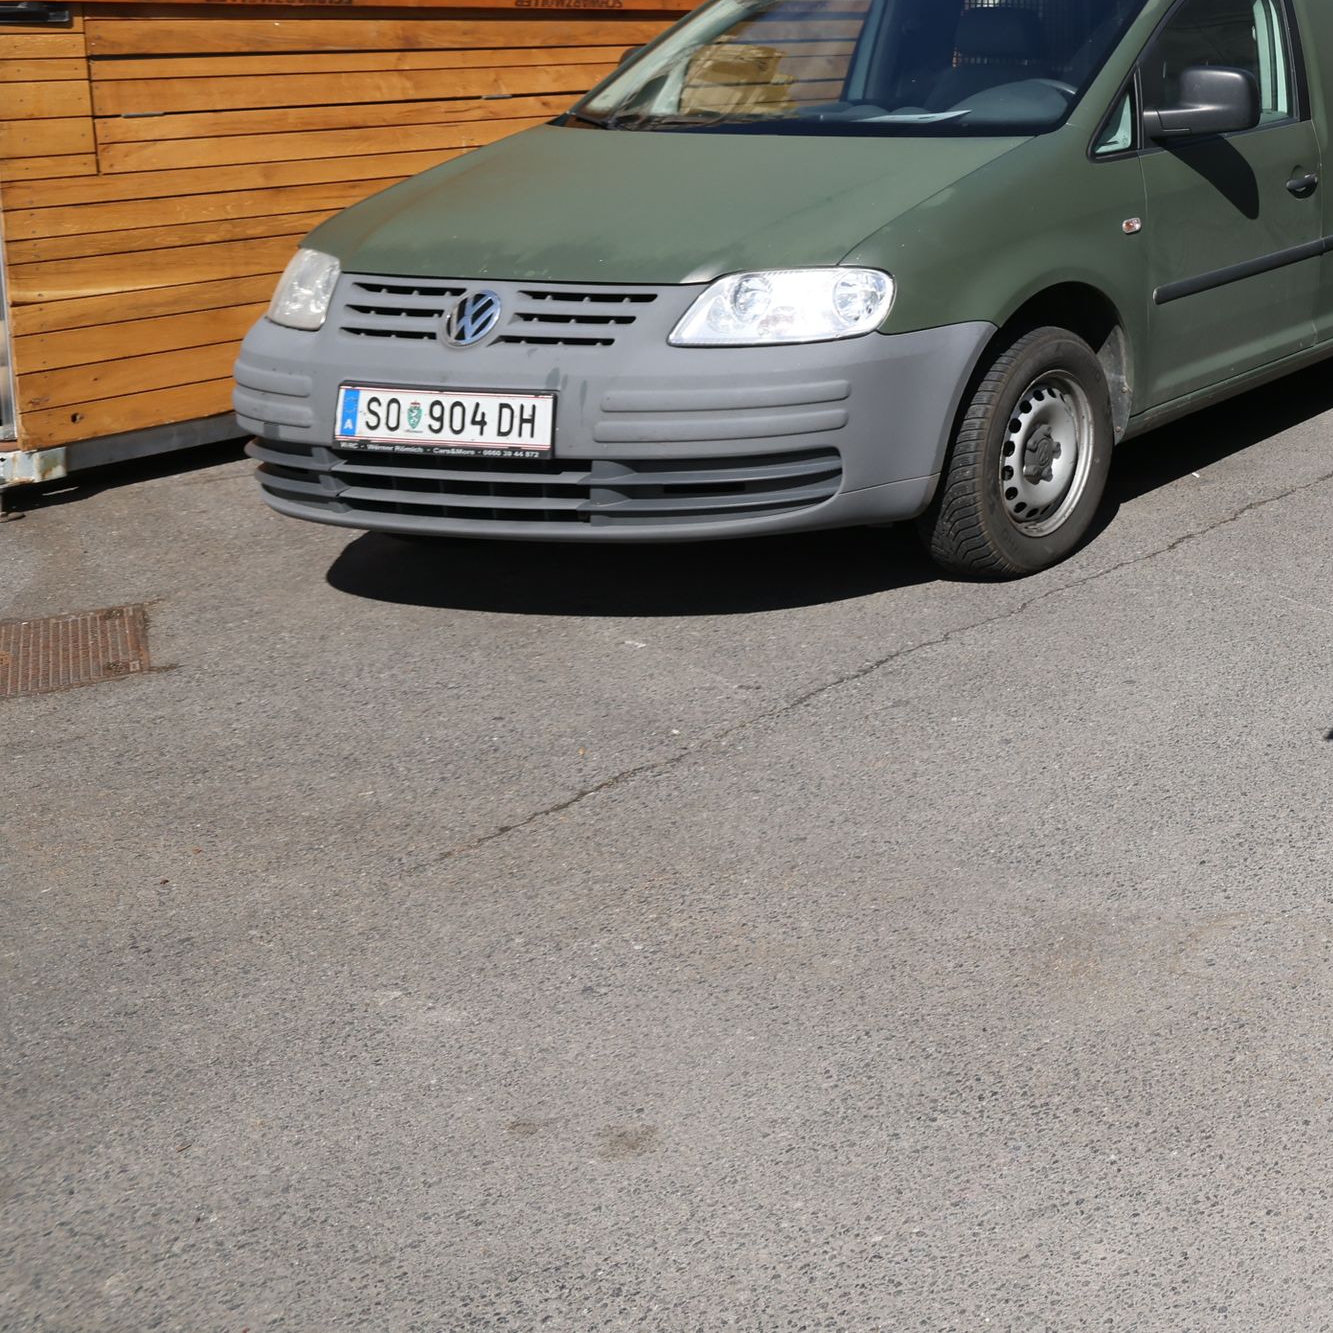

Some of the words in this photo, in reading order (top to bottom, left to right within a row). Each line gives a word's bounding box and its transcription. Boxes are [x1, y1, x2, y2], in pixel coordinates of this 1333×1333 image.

[343, 418, 354, 431] A
[428, 399, 488, 439] 904
[497, 402, 538, 439] DH
